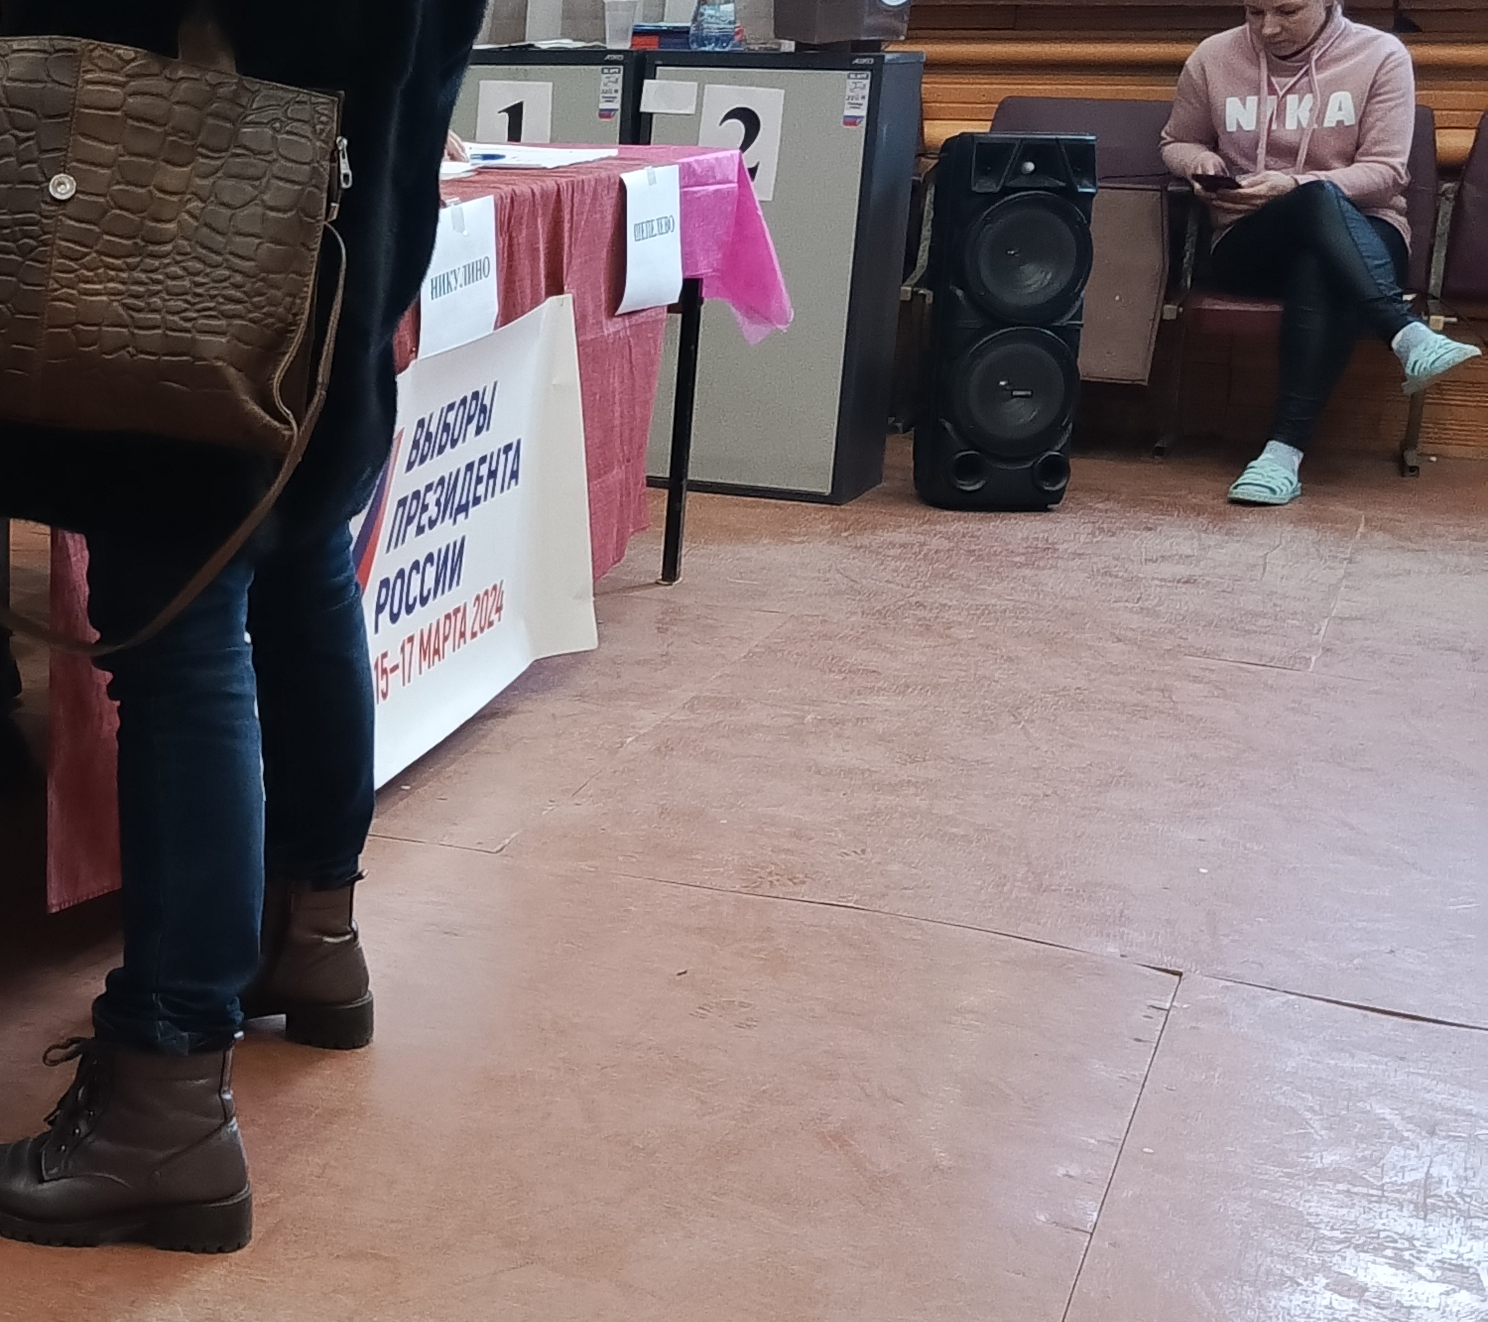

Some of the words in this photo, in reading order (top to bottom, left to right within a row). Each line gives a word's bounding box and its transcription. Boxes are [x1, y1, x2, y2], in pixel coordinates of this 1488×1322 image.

[497, 100, 524, 142] 1
[718, 107, 761, 182] 2
[1225, 91, 1356, 132] NIKA
[430, 256, 491, 300] НИКУЛИНО
[404, 380, 499, 474] ВЫБОРЫ
[385, 438, 522, 554] ПРЕЗИДЕНТА
[374, 534, 466, 635] РОССИИ
[418, 601, 468, 675] МАРТА
[470, 579, 504, 641] 2024
